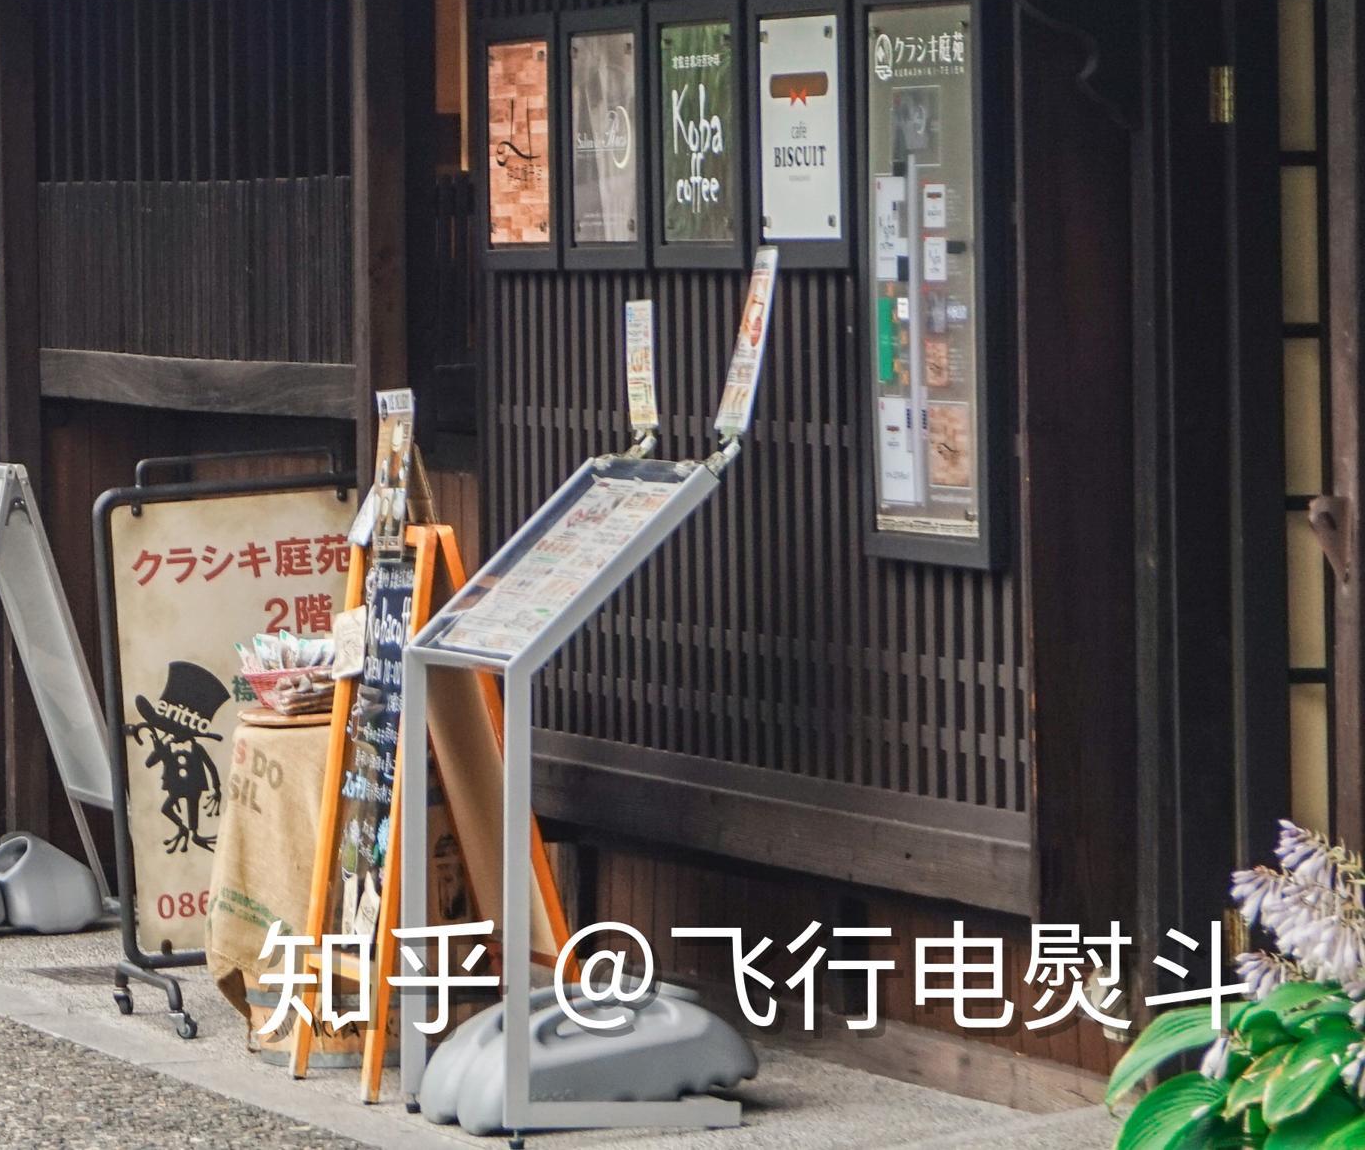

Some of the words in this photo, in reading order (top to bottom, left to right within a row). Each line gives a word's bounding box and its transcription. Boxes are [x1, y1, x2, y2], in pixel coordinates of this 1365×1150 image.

[894, 31, 965, 63] クラシキ庭苑
[671, 83, 724, 155] Koba
[774, 145, 827, 168] BISCUIT
[676, 152, 720, 213] coffee
[132, 533, 352, 586] クラシキ庭苑
[264, 593, 333, 634] 2階
[155, 699, 212, 734] eritto
